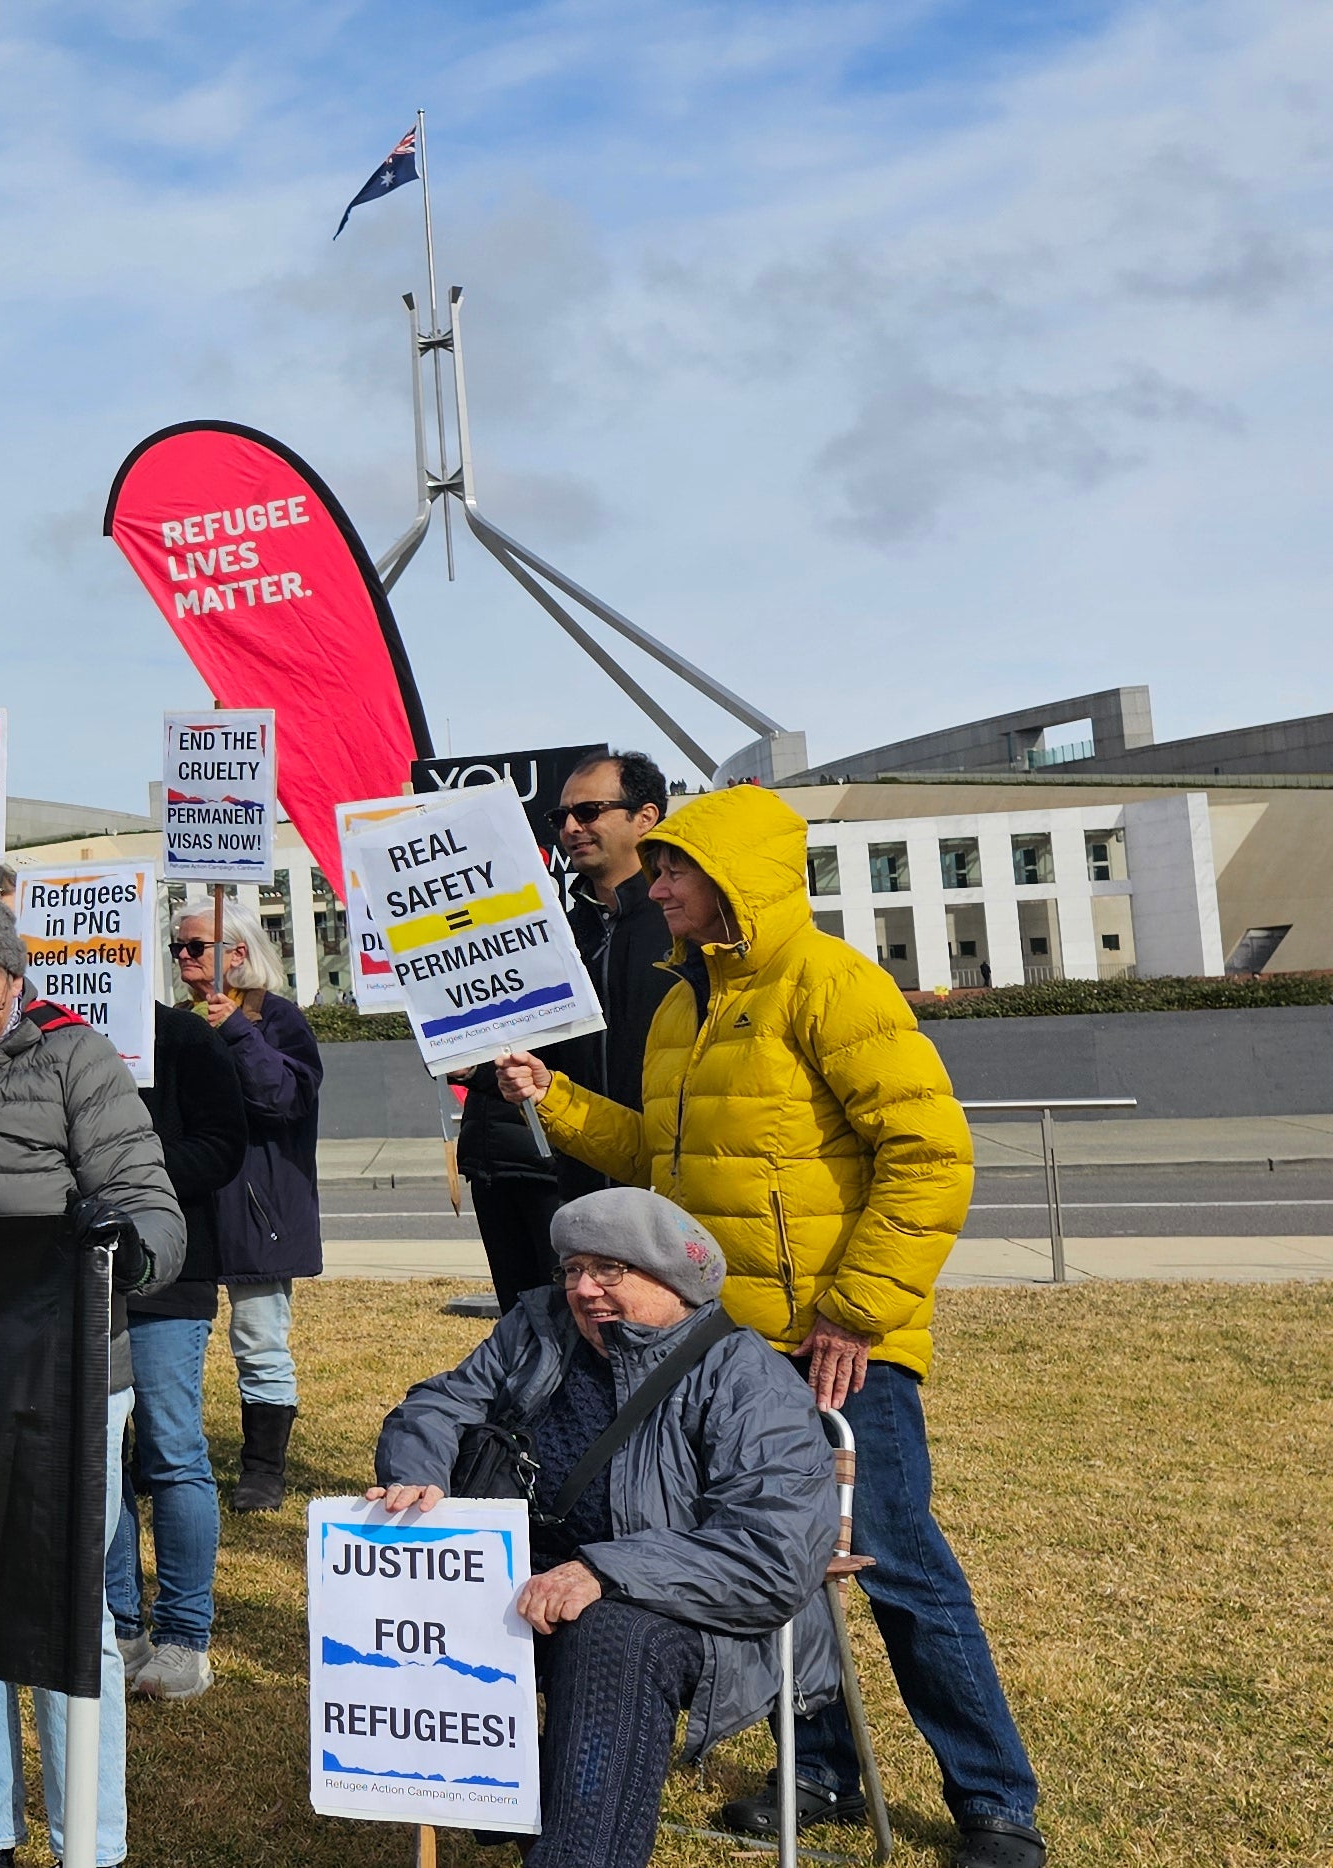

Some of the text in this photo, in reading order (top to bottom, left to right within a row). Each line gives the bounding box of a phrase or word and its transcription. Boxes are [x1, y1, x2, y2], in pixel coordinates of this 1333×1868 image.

[161, 495, 310, 547] REFUGEE
[167, 541, 260, 582] LIVES
[173, 571, 313, 619] MATTER.
[179, 731, 258, 751] END THE
[178, 761, 260, 781] CRUELTY
[167, 807, 265, 825] PERMANENT
[167, 833, 262, 850] VISAS NOW!
[387, 828, 468, 872] REAL
[31, 883, 137, 911] Refugees
[386, 861, 495, 918] SAFETY
[45, 909, 120, 937] in PNG
[75, 943, 136, 968] safety
[394, 919, 551, 986] PERMANENT
[46, 972, 112, 996] BRING
[446, 969, 525, 1009] VISAS
[429, 1033, 464, 1048] Refugee
[465, 1026, 491, 1038] Action
[538, 1002, 576, 1017] Canberra
[332, 1544, 485, 1583] JUSTICE
[375, 1618, 447, 1655] FOR
[323, 1701, 517, 1749] REFUGEES!
[325, 1778, 518, 1805] Refugee Action Campaign, Canberra
